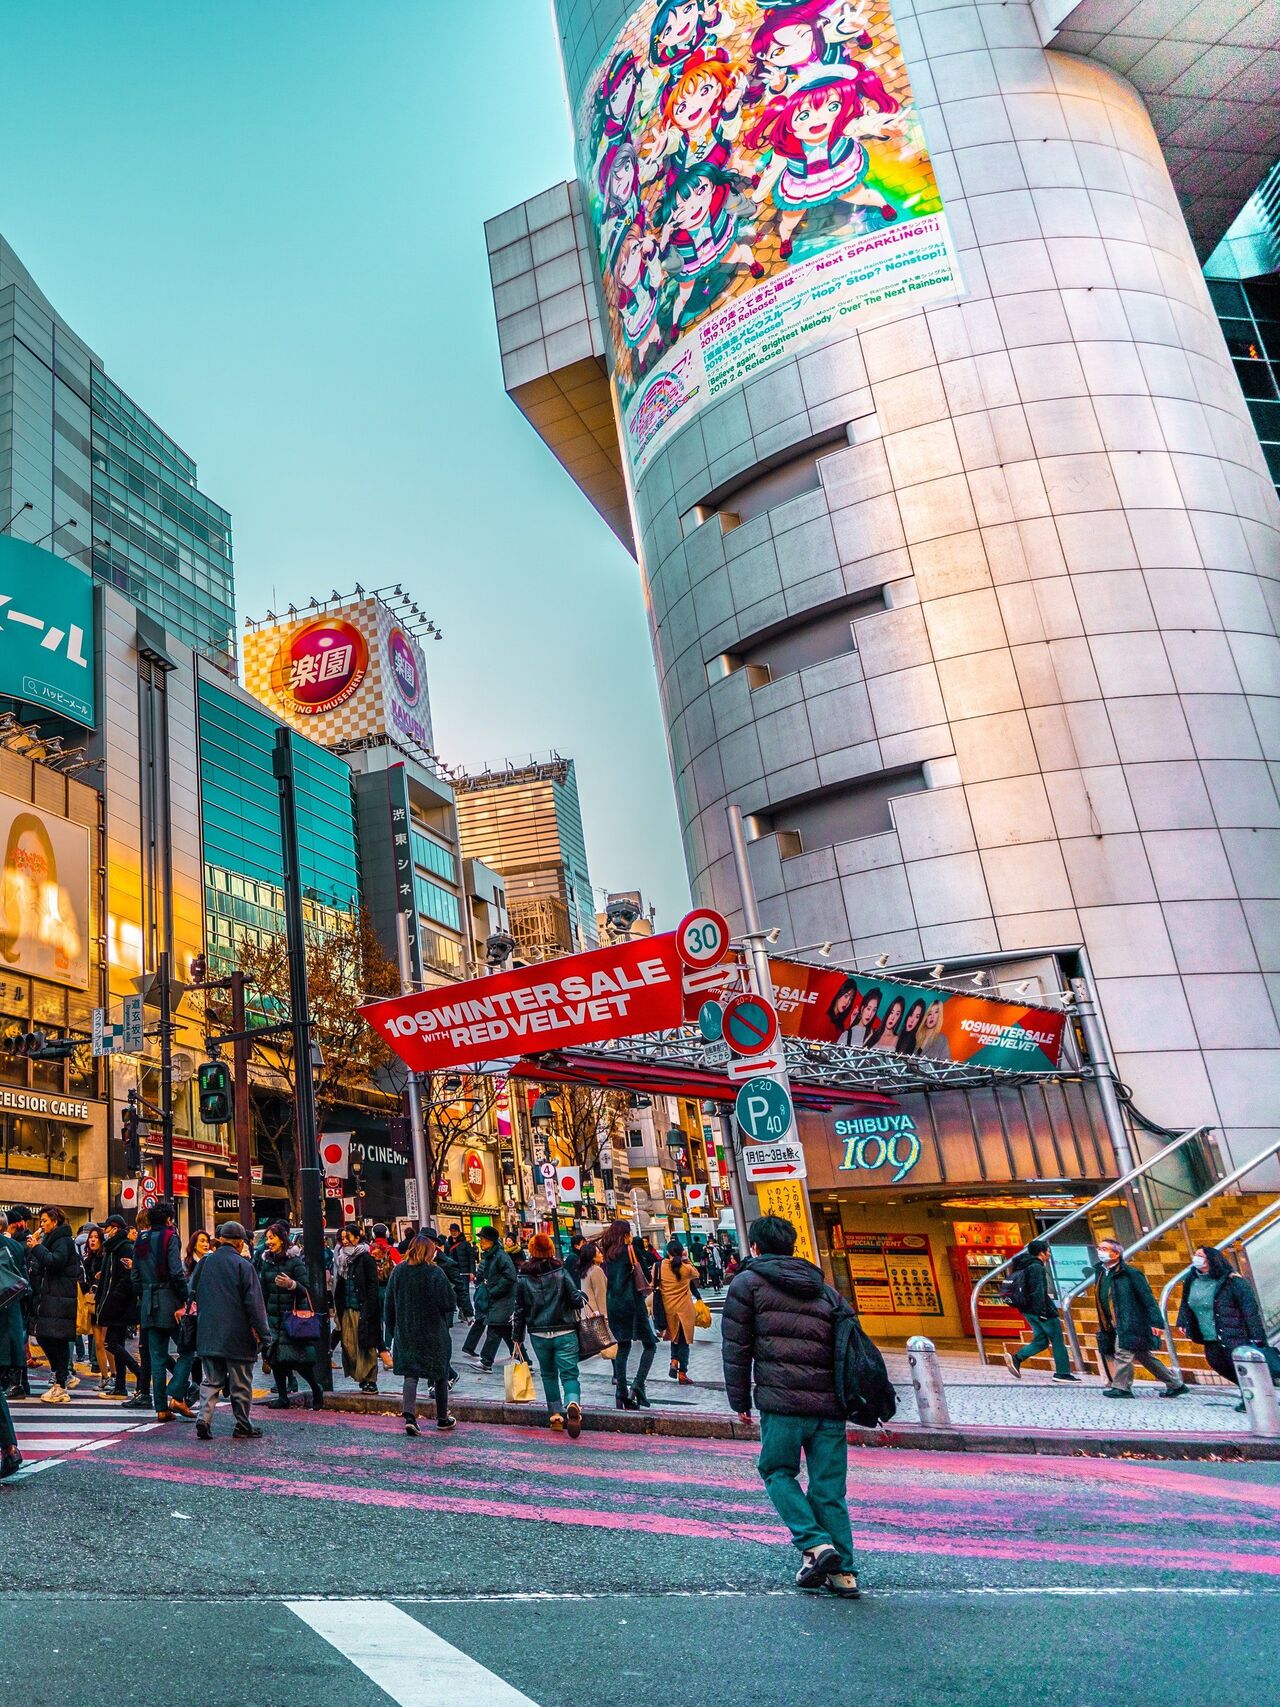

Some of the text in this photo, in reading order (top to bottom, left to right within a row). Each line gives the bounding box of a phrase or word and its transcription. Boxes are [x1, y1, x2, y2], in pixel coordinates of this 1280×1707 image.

[846, 267, 881, 286] Stop?
[864, 295, 882, 306] The
[884, 286, 906, 299] Next
[700, 296, 778, 349] 2019.1.23 Release!
[704, 319, 785, 372] 2019.1.30 Release!
[709, 345, 785, 396] 2019.2.6 Release!
[288, 643, 353, 691] 楽園
[42, 687, 88, 715] ハッピーメール
[276, 690, 314, 715] EXCITING
[315, 669, 365, 714] AMUSEMENT
[688, 923, 719, 954] 30
[735, 995, 754, 1006] 20-7
[131, 998, 141, 1047] 道玄坂下
[422, 1030, 451, 1044] WITH
[748, 1080, 772, 1093] 7-20
[50, 1099, 89, 1120] CAFFÉ
[747, 1096, 769, 1136] P
[834, 1114, 916, 1135] SHIBUYA
[367, 1145, 409, 1166] CINEM
[838, 1132, 920, 1182] 109
[543, 1165, 551, 1175] 4
[145, 1181, 154, 1189] 40
[217, 1199, 256, 1208] CINES
[792, 1185, 801, 1218] この通り
